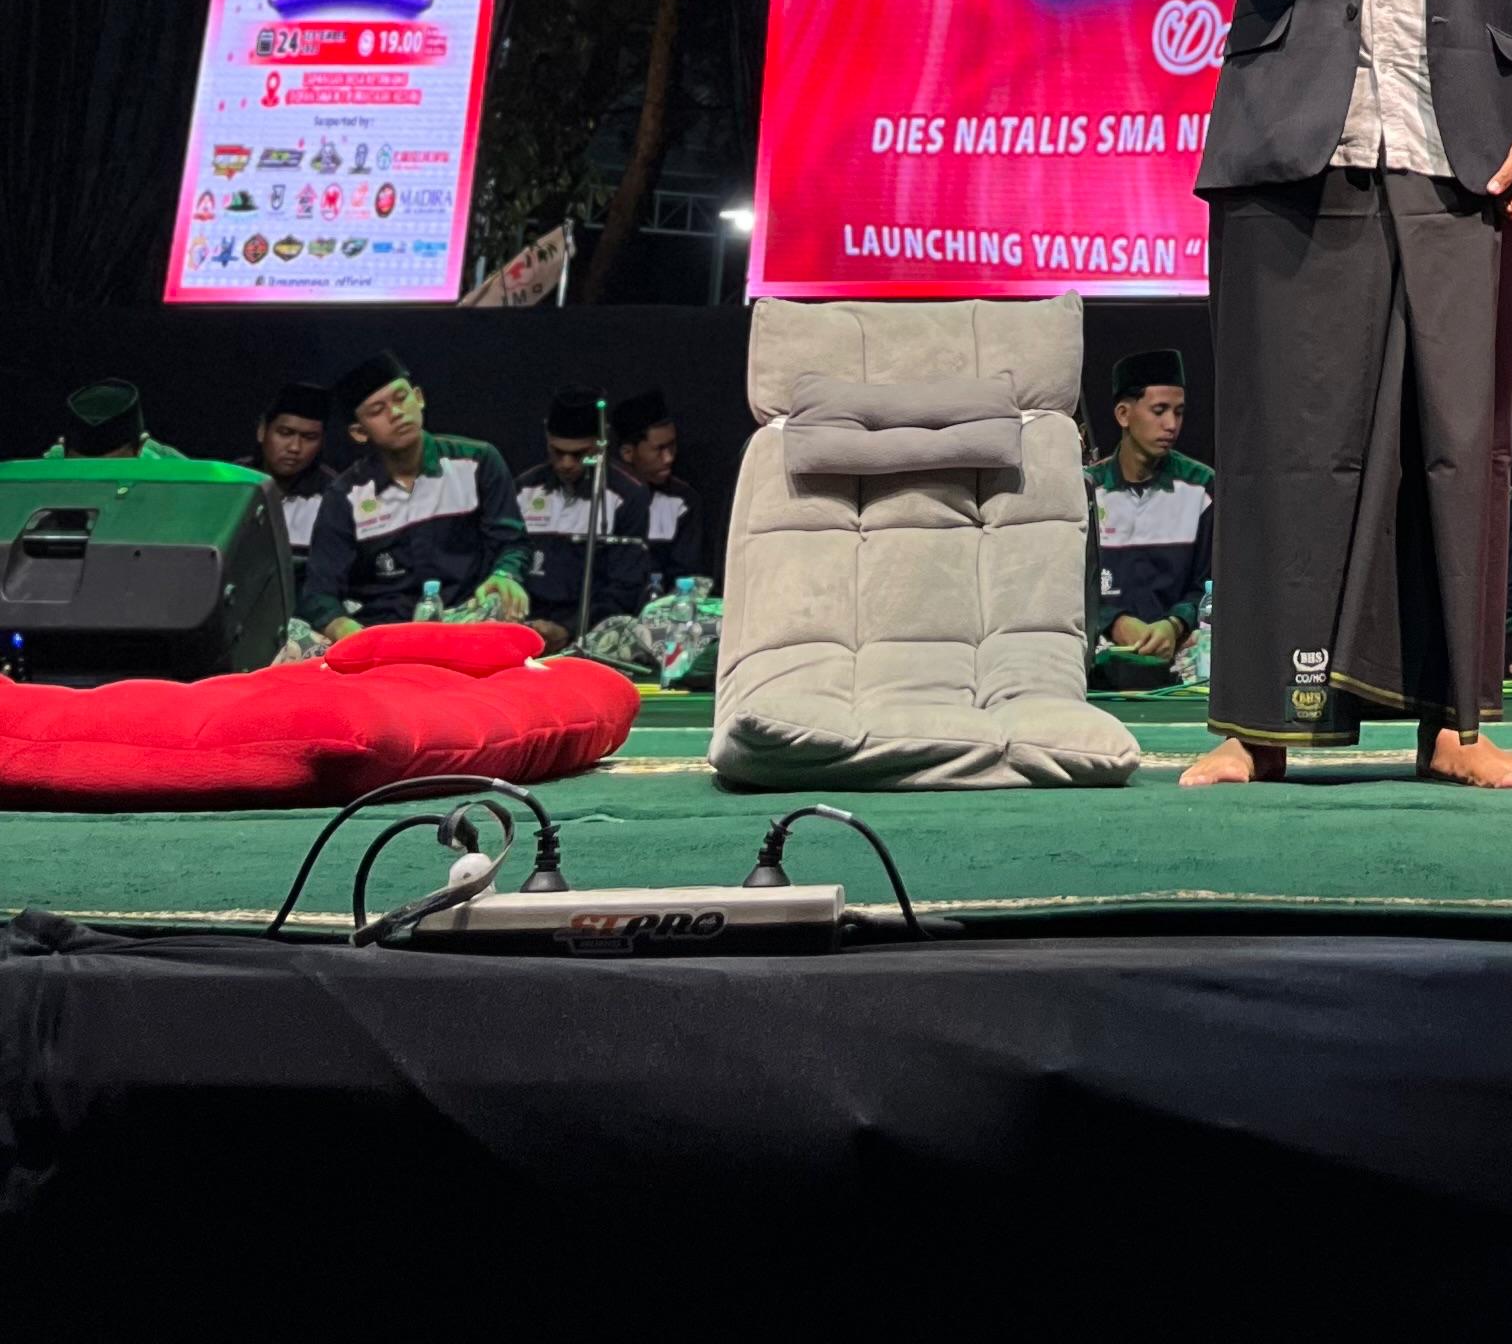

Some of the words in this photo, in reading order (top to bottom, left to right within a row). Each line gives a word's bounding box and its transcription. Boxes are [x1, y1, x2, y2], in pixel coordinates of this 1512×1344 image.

[276, 30, 299, 54] 24
[379, 30, 424, 54] 19.00
[871, 116, 945, 155] DIES
[952, 115, 1089, 155] NATALIS
[1096, 114, 1166, 153] SMA
[843, 224, 1023, 266] LAUNCHING
[1031, 233, 1176, 275] YAYASAN
[1300, 651, 1323, 664] BHS
[1299, 692, 1322, 704] BHS
